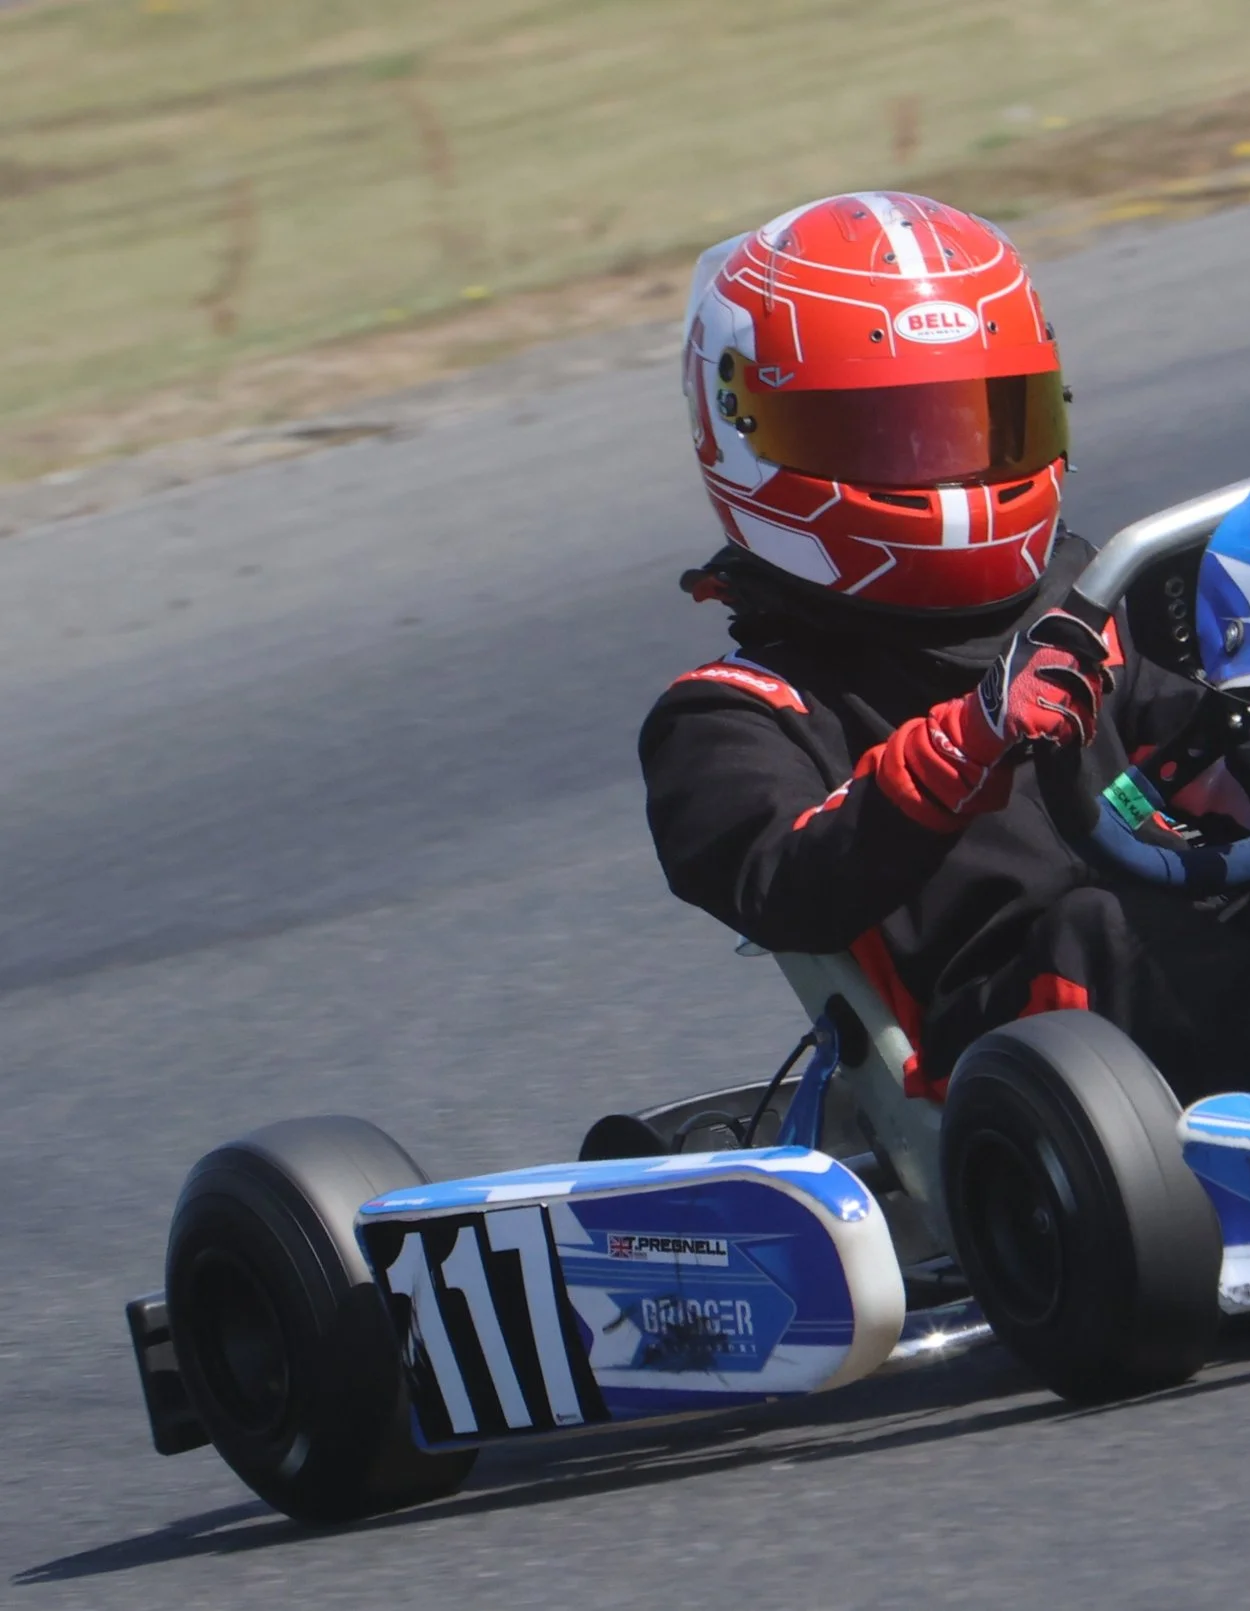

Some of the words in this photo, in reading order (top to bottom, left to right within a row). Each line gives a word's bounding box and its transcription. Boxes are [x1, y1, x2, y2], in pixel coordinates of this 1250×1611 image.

[907, 312, 967, 331] BELL
[623, 1236, 727, 1256] T.PREGNELL
[386, 1205, 585, 1435] 117
